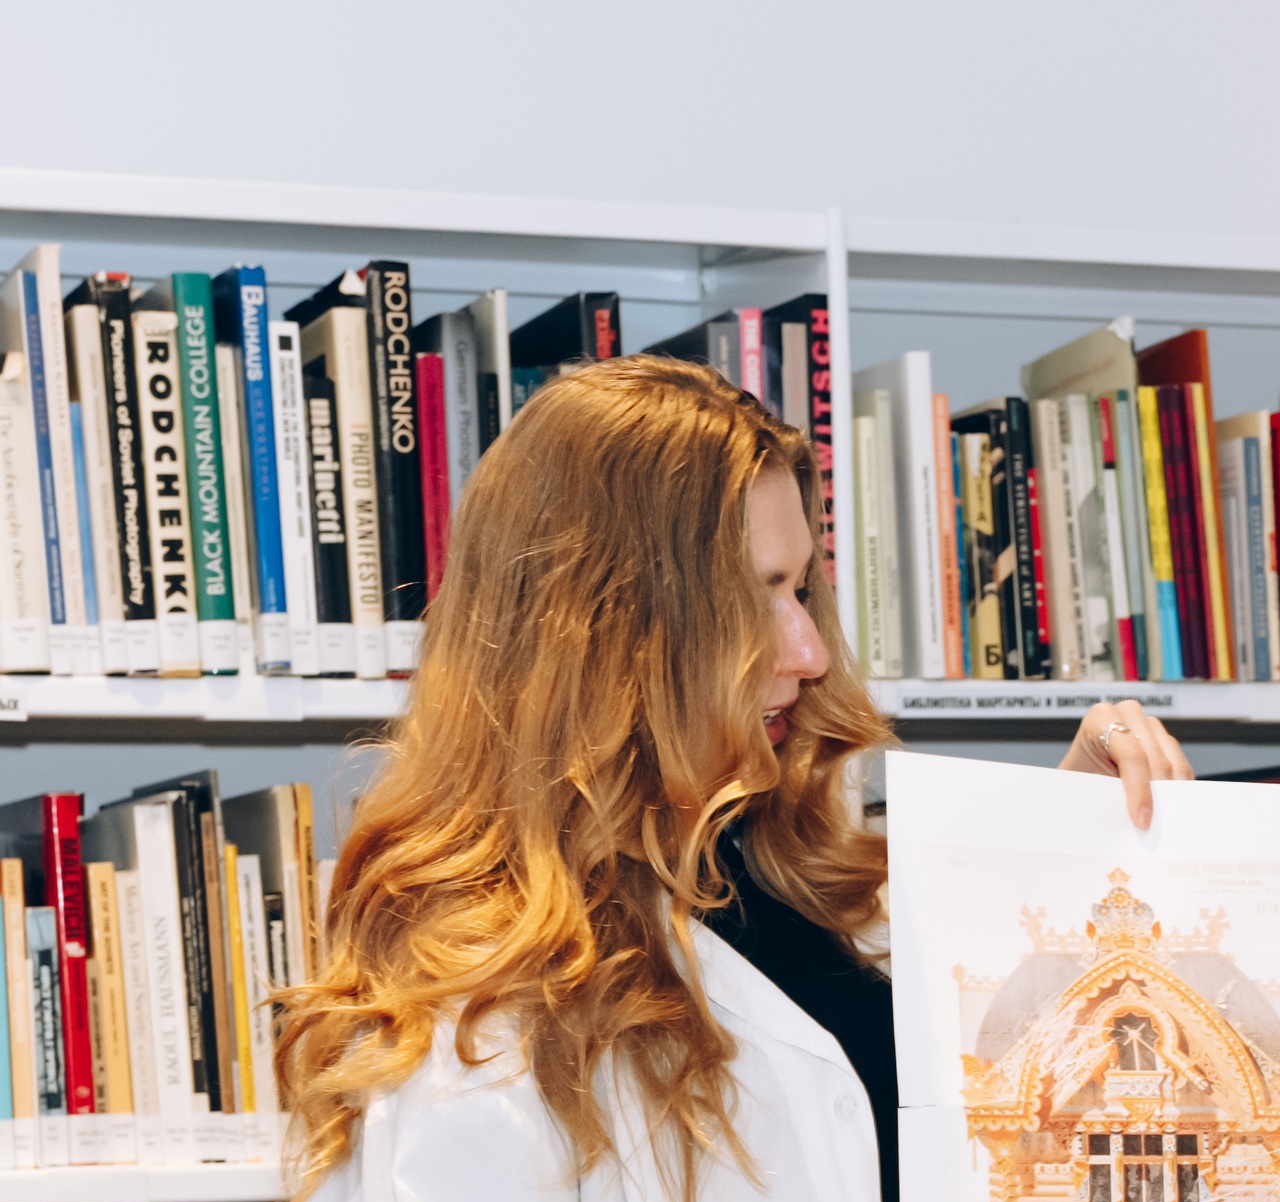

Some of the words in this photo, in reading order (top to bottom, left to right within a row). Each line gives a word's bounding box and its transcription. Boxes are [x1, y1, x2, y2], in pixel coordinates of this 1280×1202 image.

[105, 318, 131, 402] Pioneers
[184, 305, 211, 399] COLLEGE
[241, 285, 265, 381] BAUHAUS
[384, 271, 416, 454] RODCHENKO
[455, 340, 471, 403] German
[114, 405, 132, 426] of
[456, 410, 472, 477] Photogr
[115, 427, 137, 486] Soviet
[195, 405, 220, 521] MOUNTAIN
[309, 398, 345, 545] marinetti
[350, 431, 370, 488] PHOTO
[1012, 453, 1024, 477] THE
[117, 488, 148, 605] Photography
[355, 498, 379, 605] MANIFESTO
[1013, 483, 1029, 559] STRUCTURE
[11, 559, 30, 619] Surrealis
[203, 530, 226, 596] BLACK
[1020, 581, 1032, 606] ART
[903, 696, 971, 709] БИБЛИОТЕКА
[977, 695, 1040, 709] МАРГАРИТЫ
[59, 837, 83, 938] MALEVICH
[100, 880, 108, 897] ART
[102, 916, 110, 932] THE
[104, 937, 113, 974] SOVIETS
[152, 915, 175, 1017] HAUSMANN
[162, 1023, 181, 1085] RAOUL
